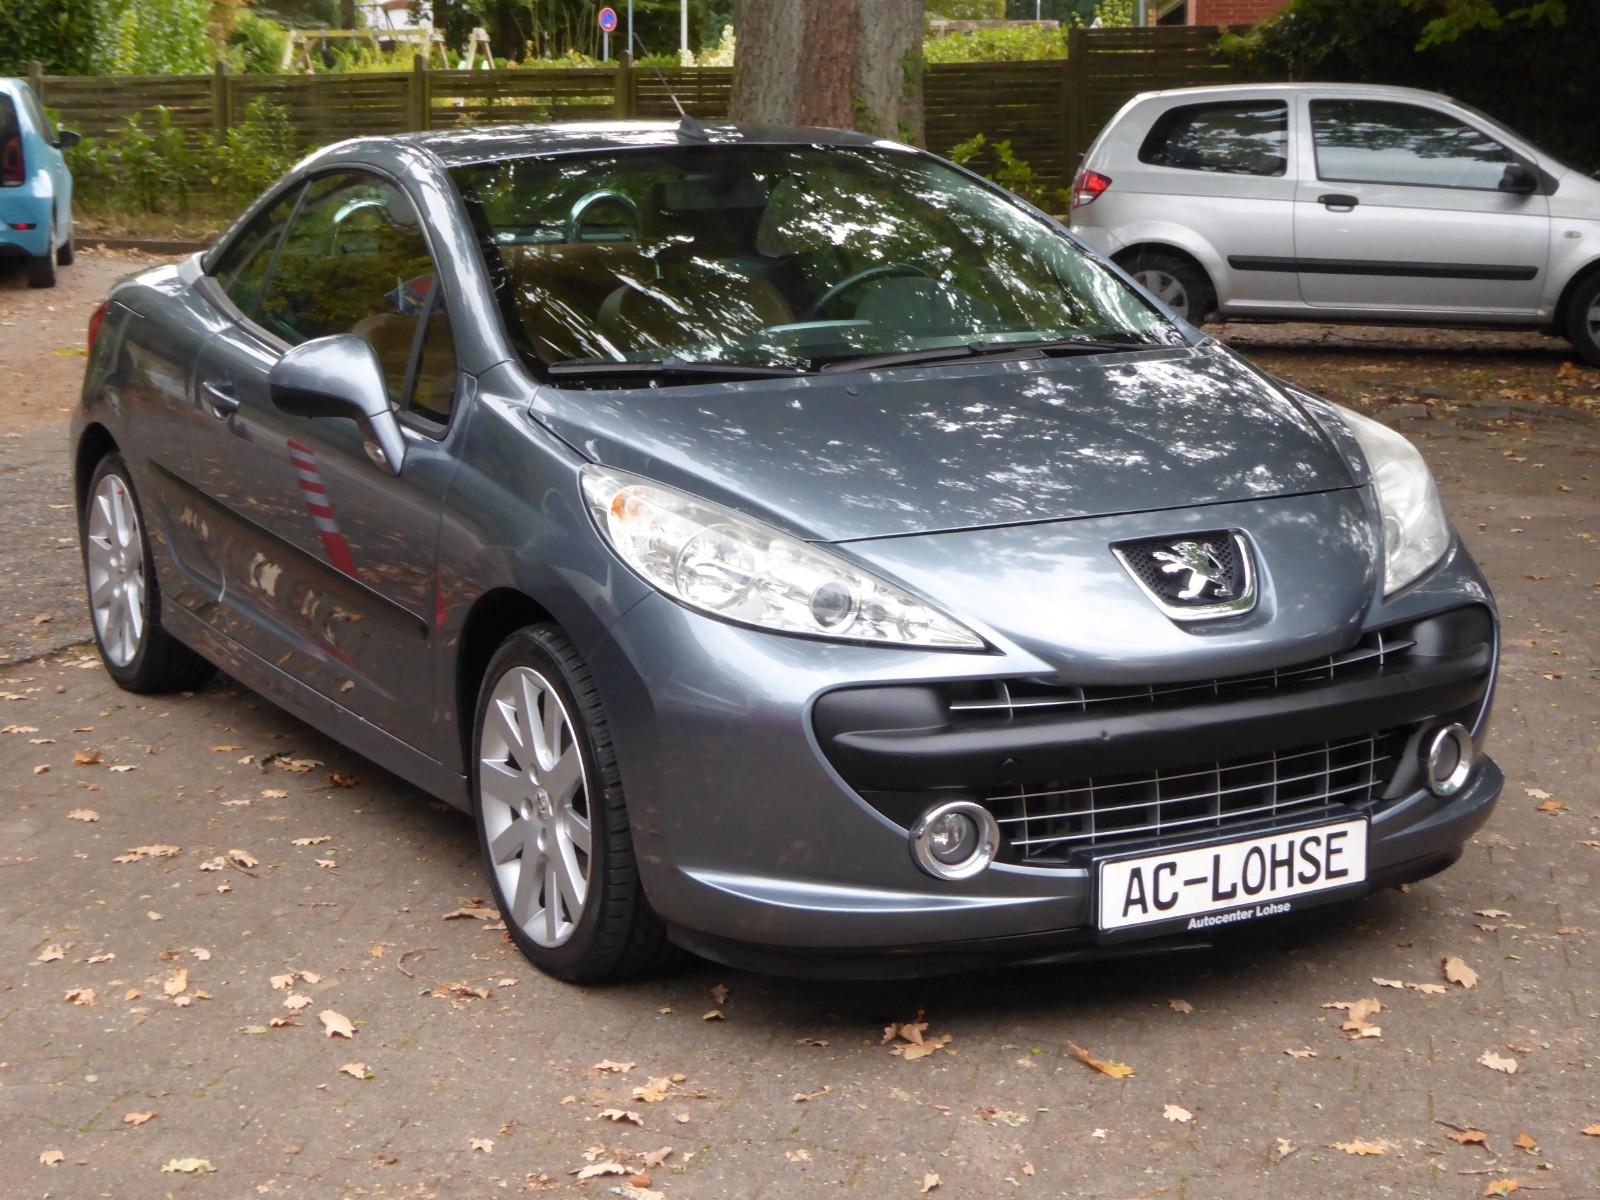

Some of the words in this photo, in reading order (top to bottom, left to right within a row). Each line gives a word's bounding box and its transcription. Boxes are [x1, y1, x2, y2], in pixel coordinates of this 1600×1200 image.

[1122, 830, 1348, 917] AC-LOHSE
[1187, 908, 1253, 930] Autocenter
[1255, 901, 1291, 918] Lohse
